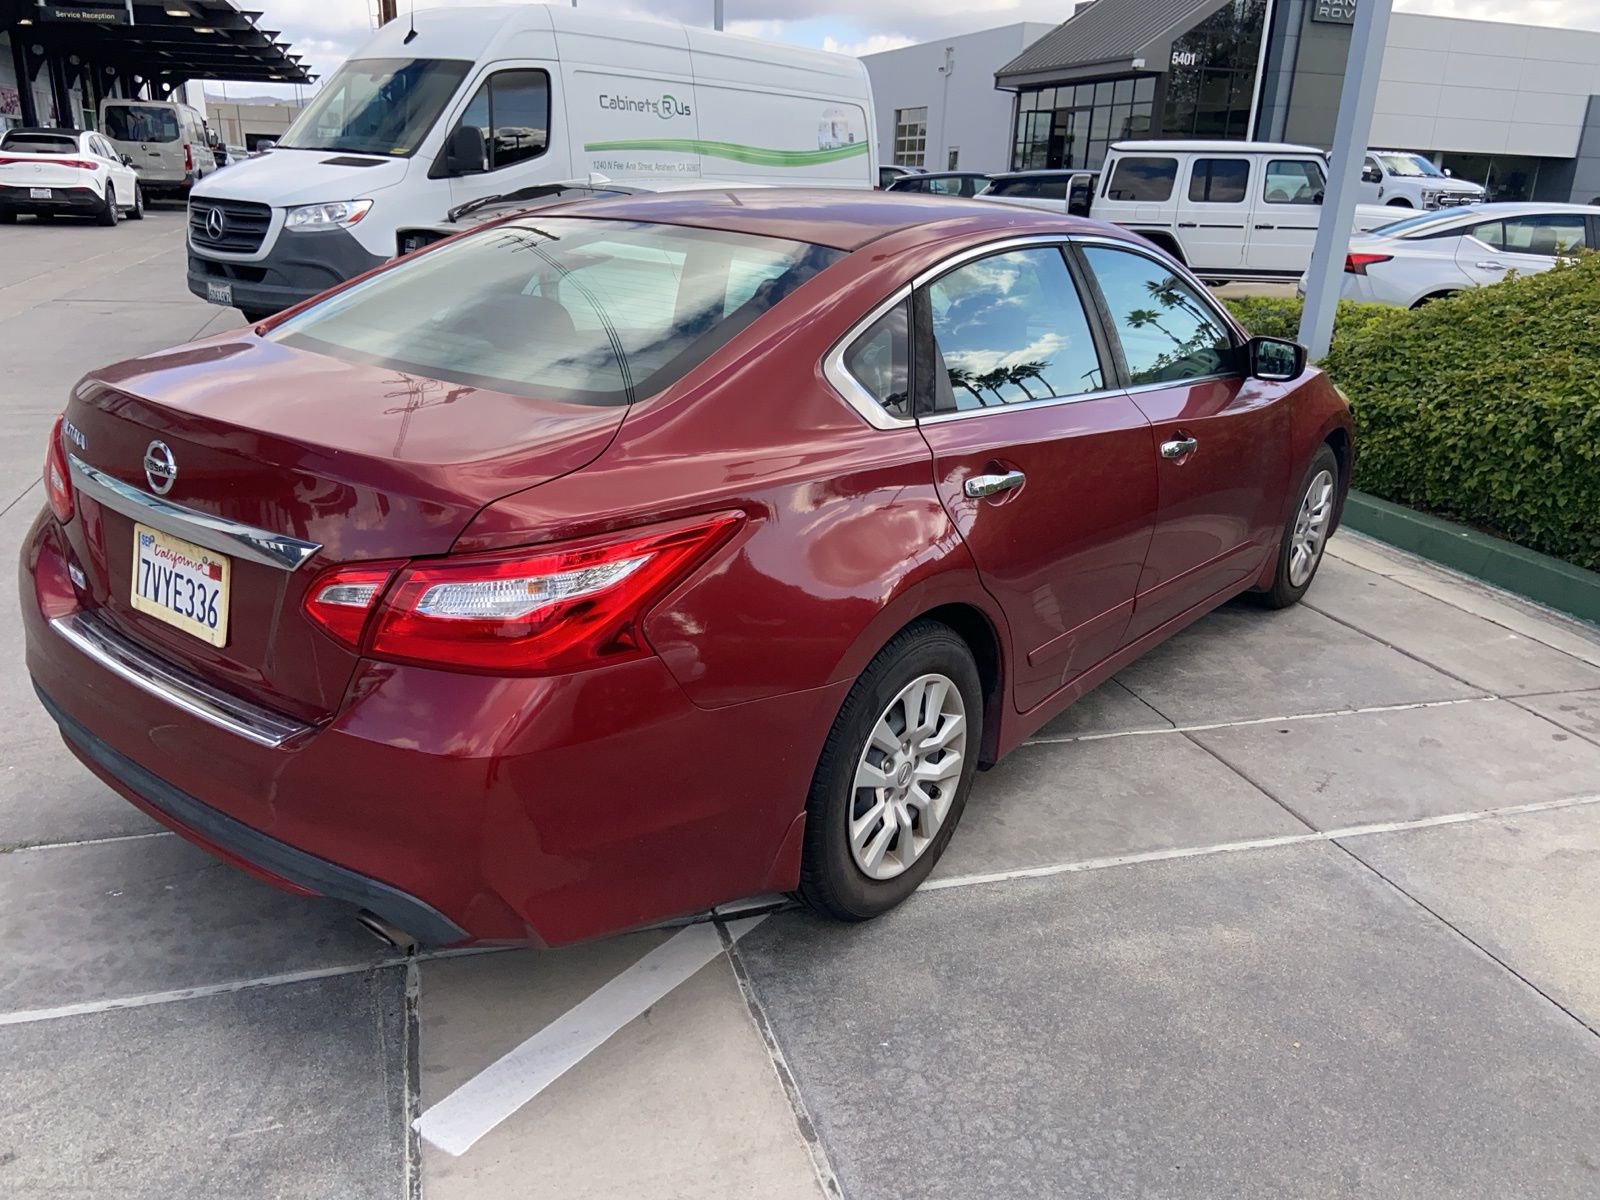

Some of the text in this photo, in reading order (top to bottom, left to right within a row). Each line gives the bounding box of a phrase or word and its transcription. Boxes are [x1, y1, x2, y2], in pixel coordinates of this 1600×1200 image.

[55, 10, 115, 20] Service Reception
[1319, 6, 1355, 18] ROV
[1171, 51, 1197, 66] 5401
[599, 94, 659, 114] Cabinets
[153, 543, 207, 575] California
[142, 558, 219, 628] 7VYE336
